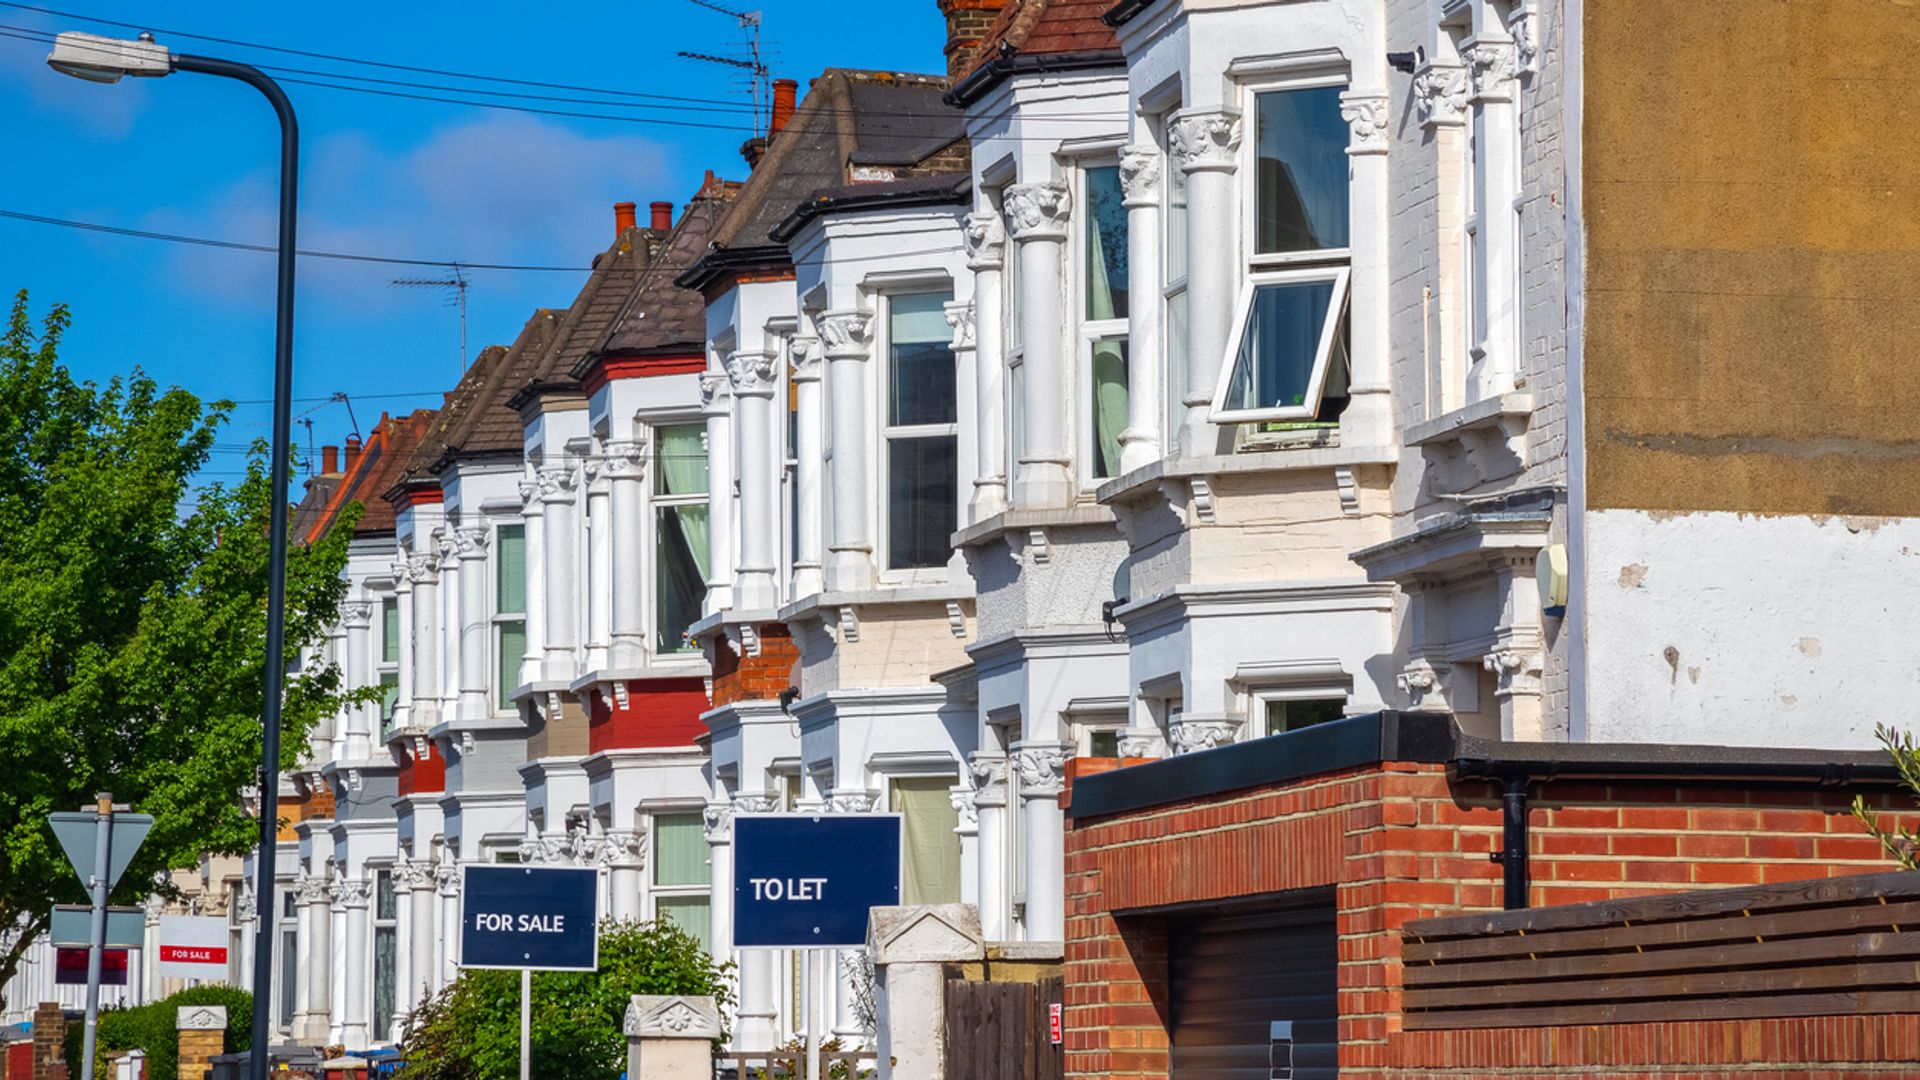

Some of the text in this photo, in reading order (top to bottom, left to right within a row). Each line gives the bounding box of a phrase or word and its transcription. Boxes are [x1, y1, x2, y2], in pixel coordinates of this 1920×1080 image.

[749, 878, 828, 900] TO LET
[476, 913, 564, 933] FOR SALE
[172, 950, 210, 960] FOR SALE
